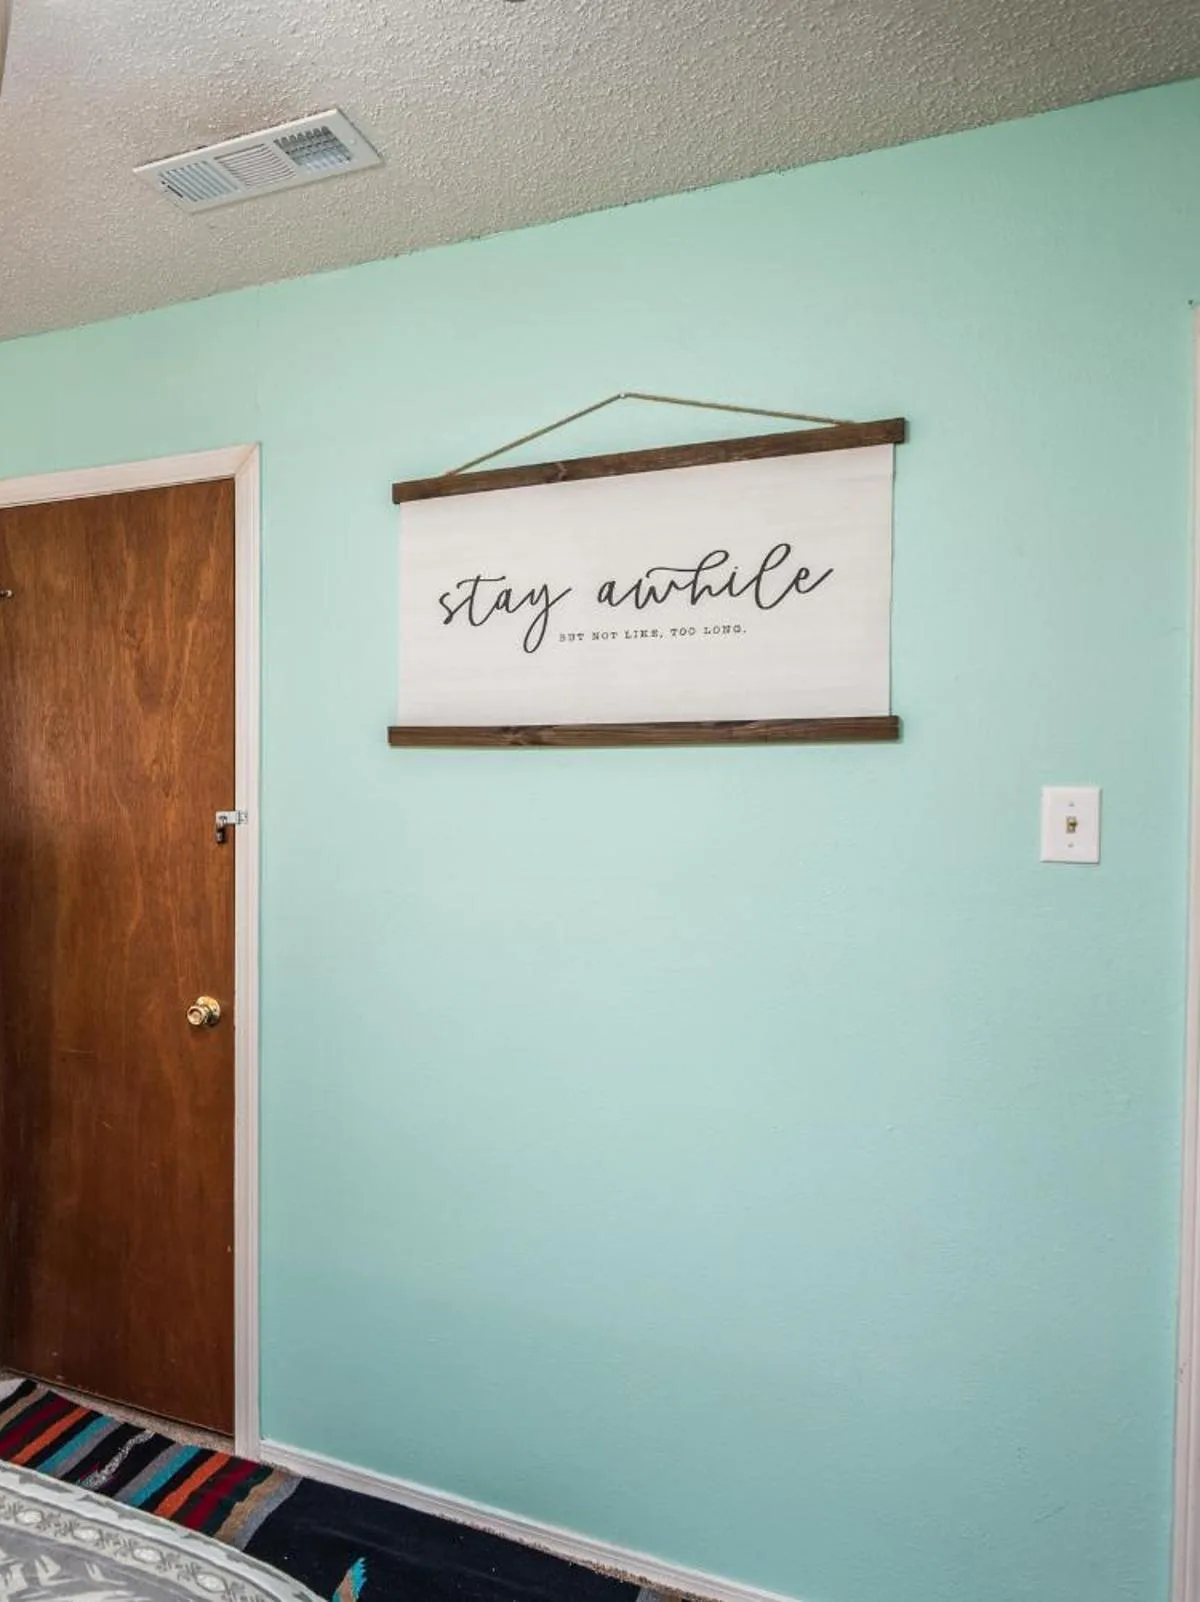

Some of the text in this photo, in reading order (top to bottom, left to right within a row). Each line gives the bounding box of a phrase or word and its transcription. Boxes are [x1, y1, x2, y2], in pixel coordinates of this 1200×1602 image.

[438, 543, 834, 654] stay awhile
[559, 624, 747, 643] BUT NOT LIKE, TOO LONG.
